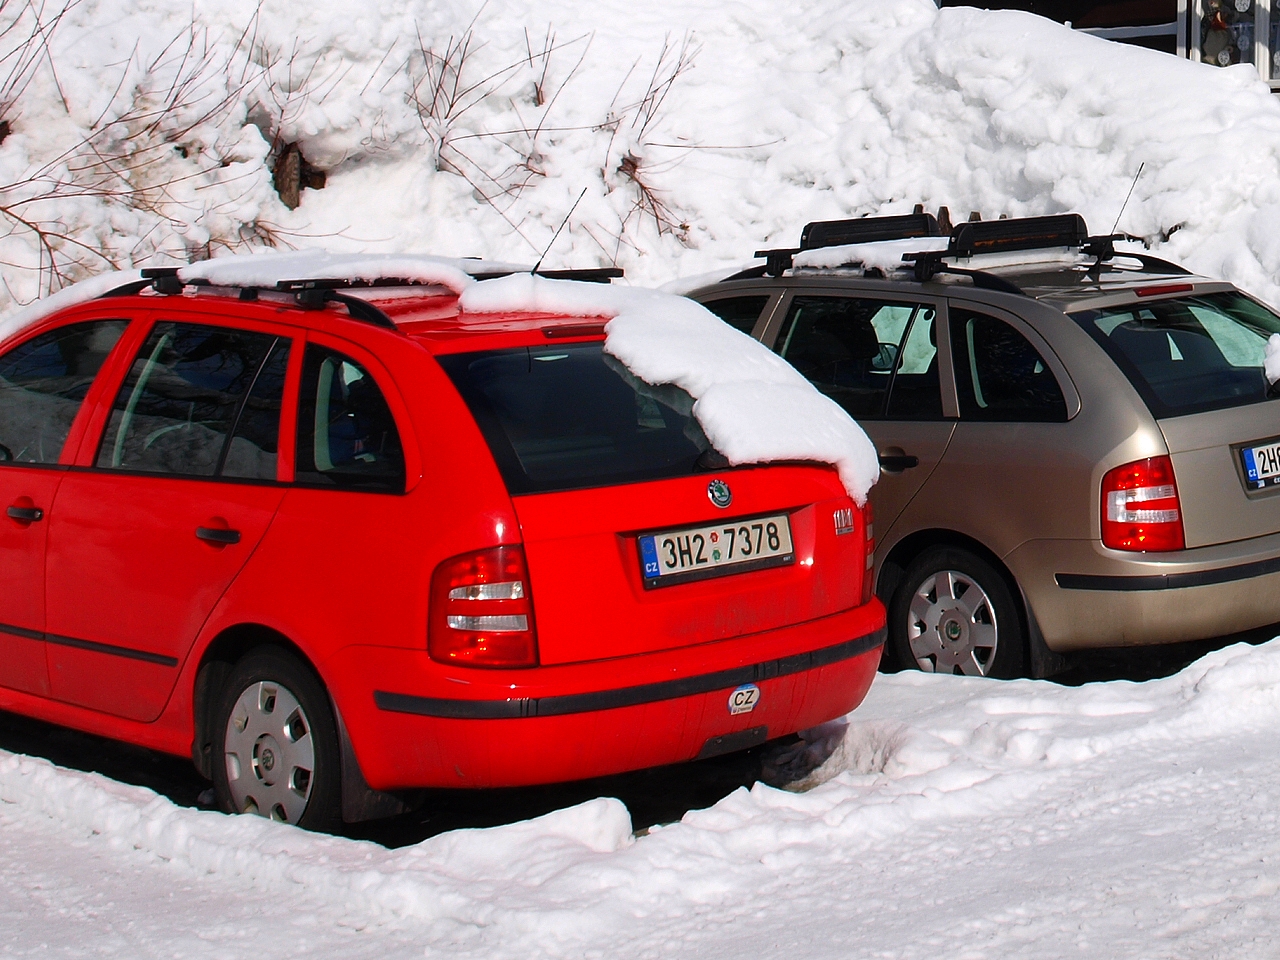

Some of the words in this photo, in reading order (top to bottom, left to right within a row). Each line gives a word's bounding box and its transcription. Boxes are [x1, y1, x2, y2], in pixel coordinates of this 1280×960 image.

[1248, 469, 1257, 478] CZ
[662, 534, 708, 569] 3H2
[723, 522, 780, 559] 7378
[645, 562, 658, 573] CZ
[734, 690, 755, 706] CZ
